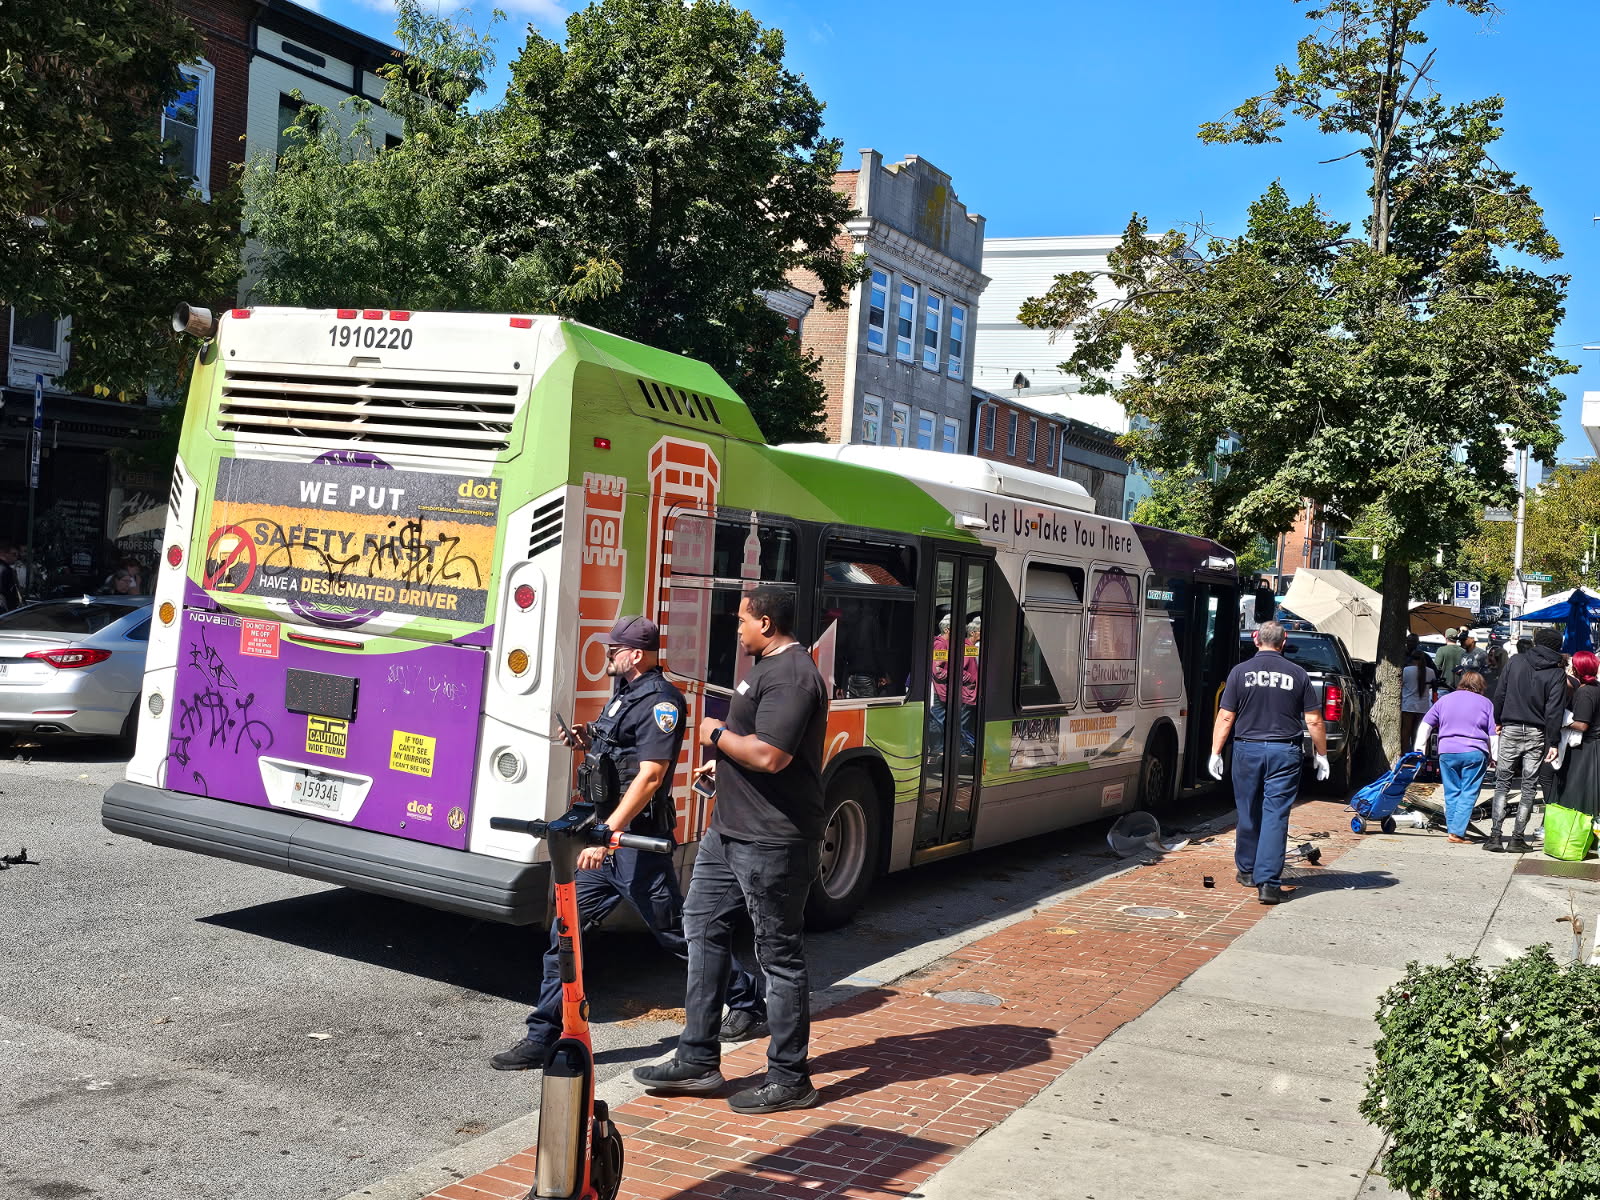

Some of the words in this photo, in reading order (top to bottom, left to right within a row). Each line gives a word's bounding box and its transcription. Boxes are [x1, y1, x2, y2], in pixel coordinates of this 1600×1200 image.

[329, 325, 413, 350] 1910220
[300, 481, 337, 505] WE
[350, 484, 405, 510] PUT
[458, 479, 498, 499] dot
[985, 502, 1006, 534] Let
[1014, 508, 1030, 537] Us
[1038, 513, 1067, 543] Take
[1074, 519, 1095, 547] You
[1102, 525, 1131, 553] There
[254, 522, 355, 553] SAFETY
[363, 533, 442, 563] FIRST
[259, 574, 289, 592] HAVE
[290, 578, 298, 592] A
[300, 577, 397, 604] DESIGNATED
[399, 587, 458, 611] DRIVER
[309, 729, 345, 746] CAUTION
[412, 737, 424, 746] YOU
[308, 743, 323, 752] WIDE
[324, 745, 345, 756] TURNS
[398, 744, 415, 753] CAN'T
[416, 747, 427, 756] SEE
[393, 751, 402, 759] MY
[403, 753, 431, 766] MIRRORS
[395, 761, 409, 769] CAN'T
[420, 765, 430, 773] YOU
[407, 800, 433, 816] dot
